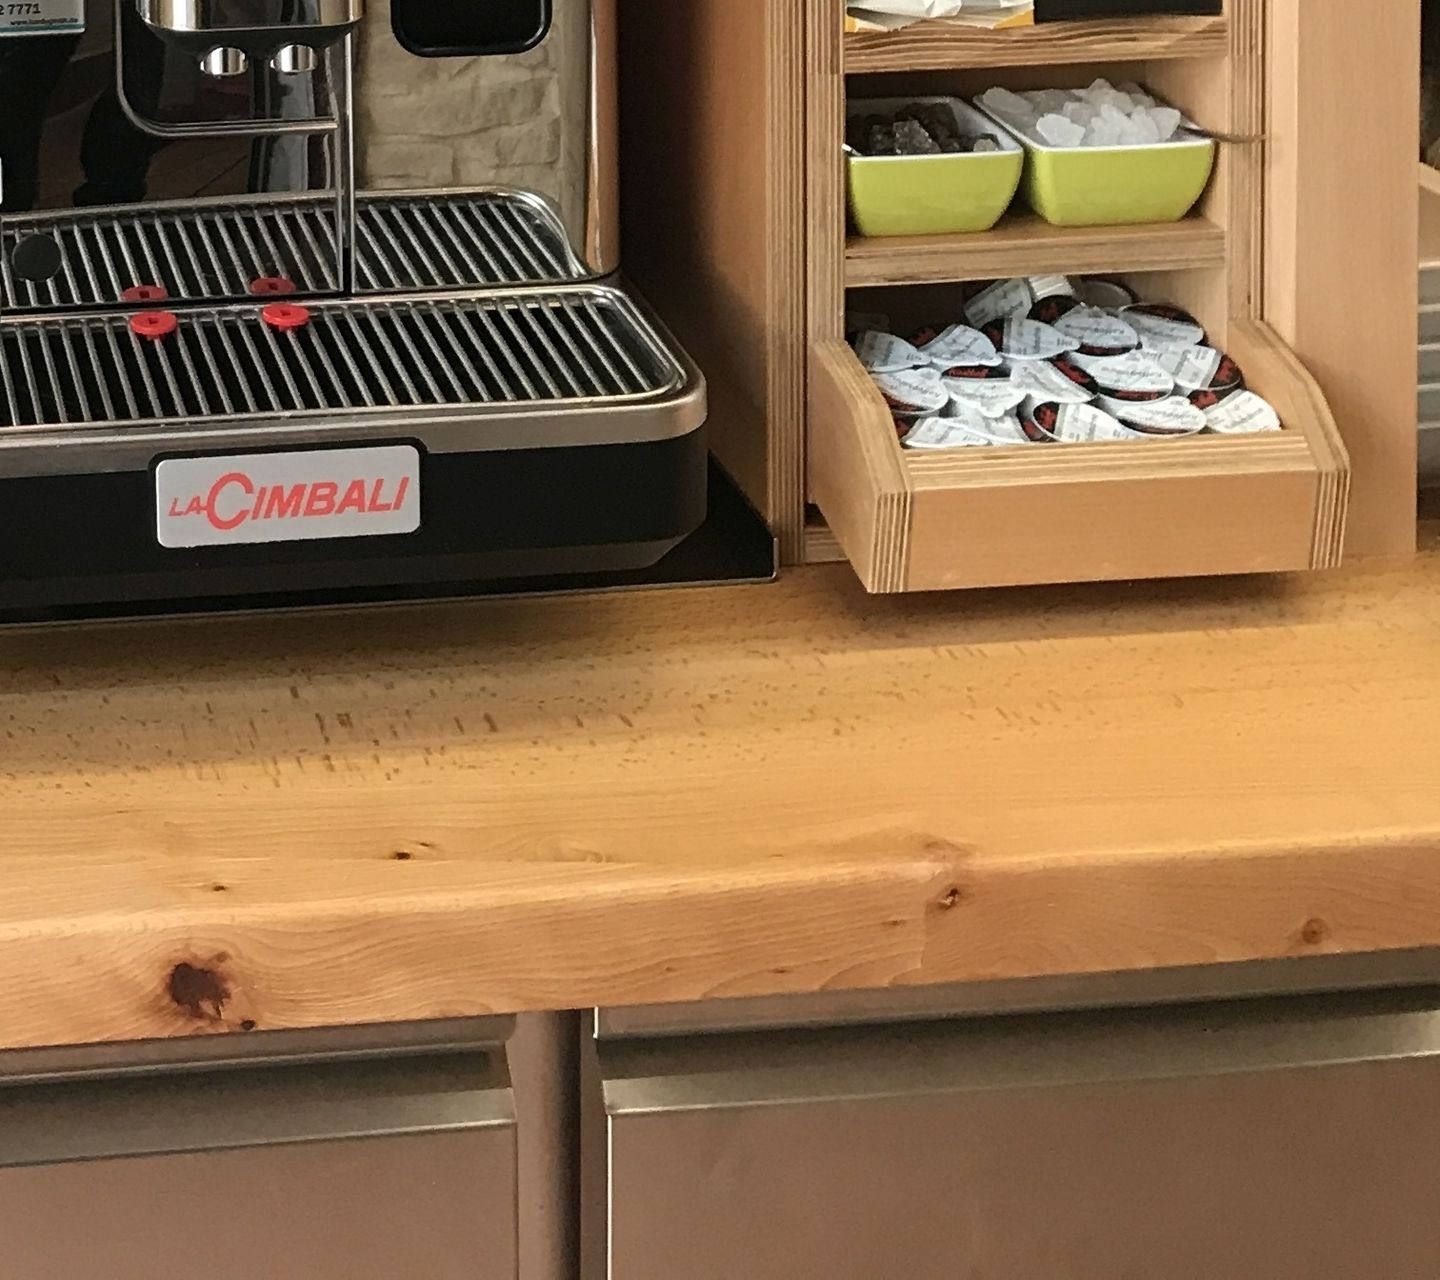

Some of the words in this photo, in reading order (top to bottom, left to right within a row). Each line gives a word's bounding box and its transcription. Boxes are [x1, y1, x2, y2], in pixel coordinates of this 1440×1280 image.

[8, 3, 42, 15] 7771
[168, 496, 207, 517] LA
[207, 472, 410, 530] CIMBALI
